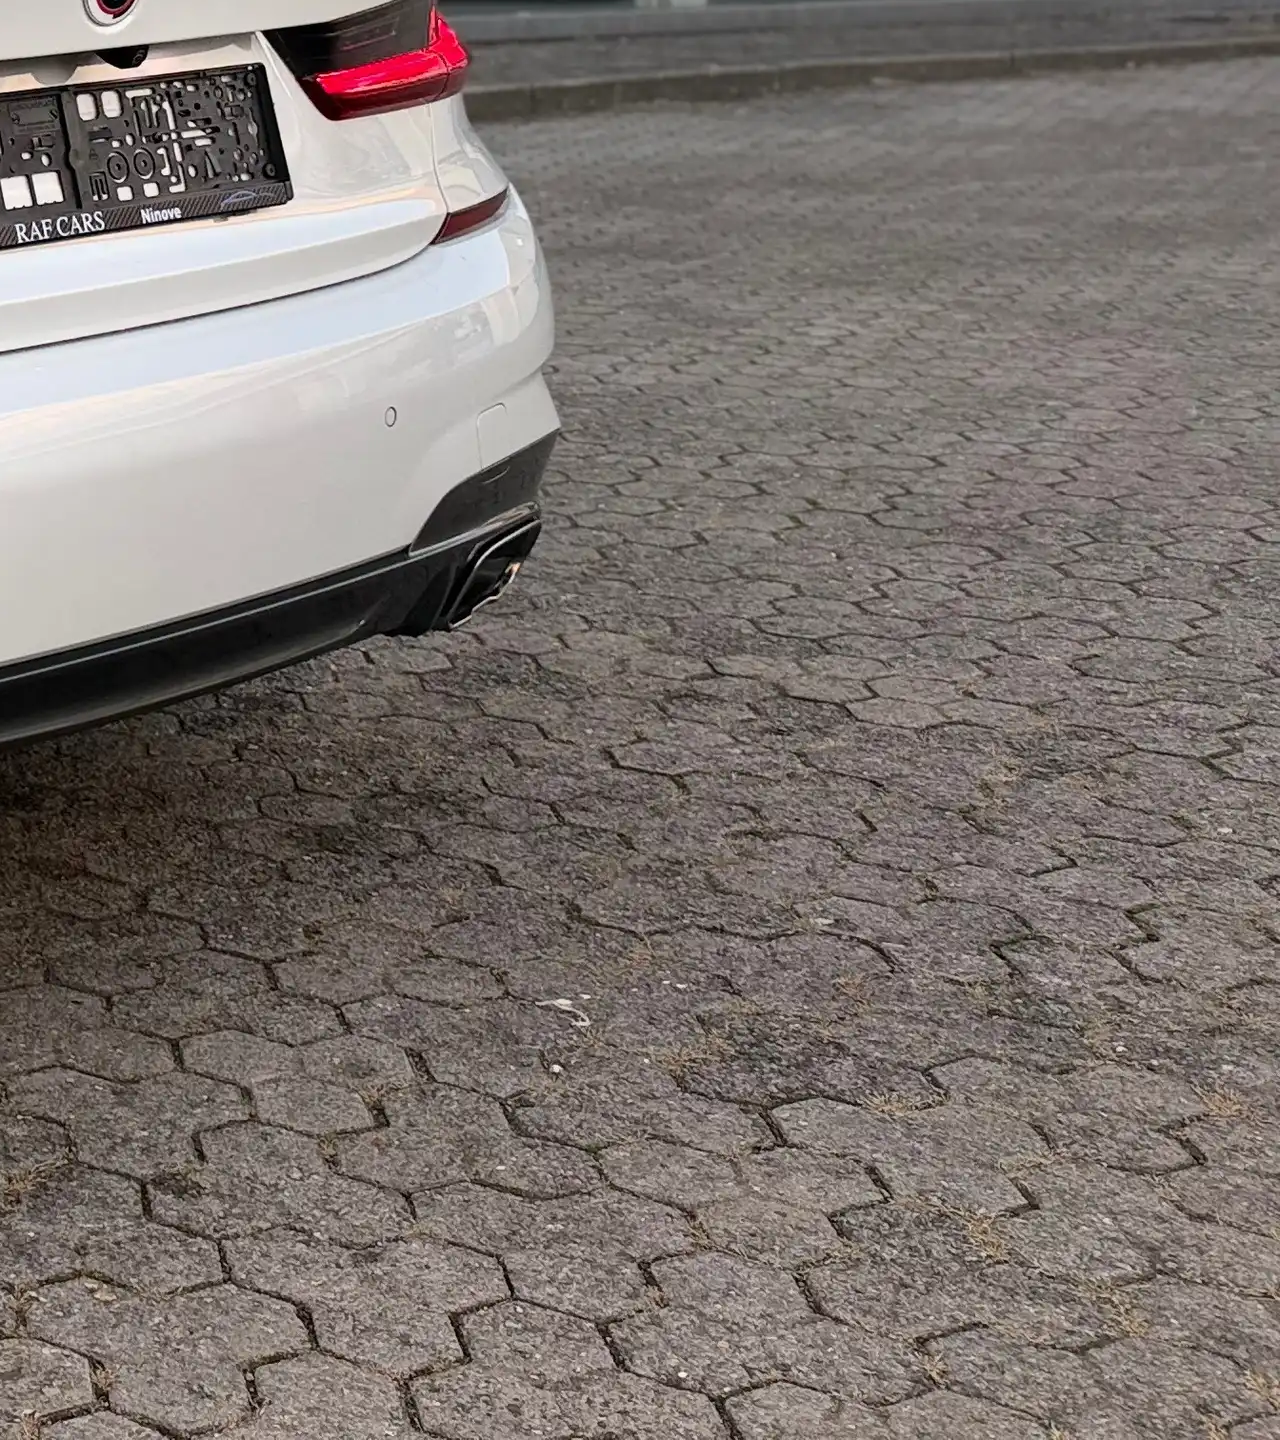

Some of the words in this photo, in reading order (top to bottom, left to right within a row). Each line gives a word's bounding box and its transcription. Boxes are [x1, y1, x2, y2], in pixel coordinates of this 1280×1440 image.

[15, 219, 53, 244] RAF
[58, 210, 106, 237] CARS
[141, 205, 182, 224] Ninove
